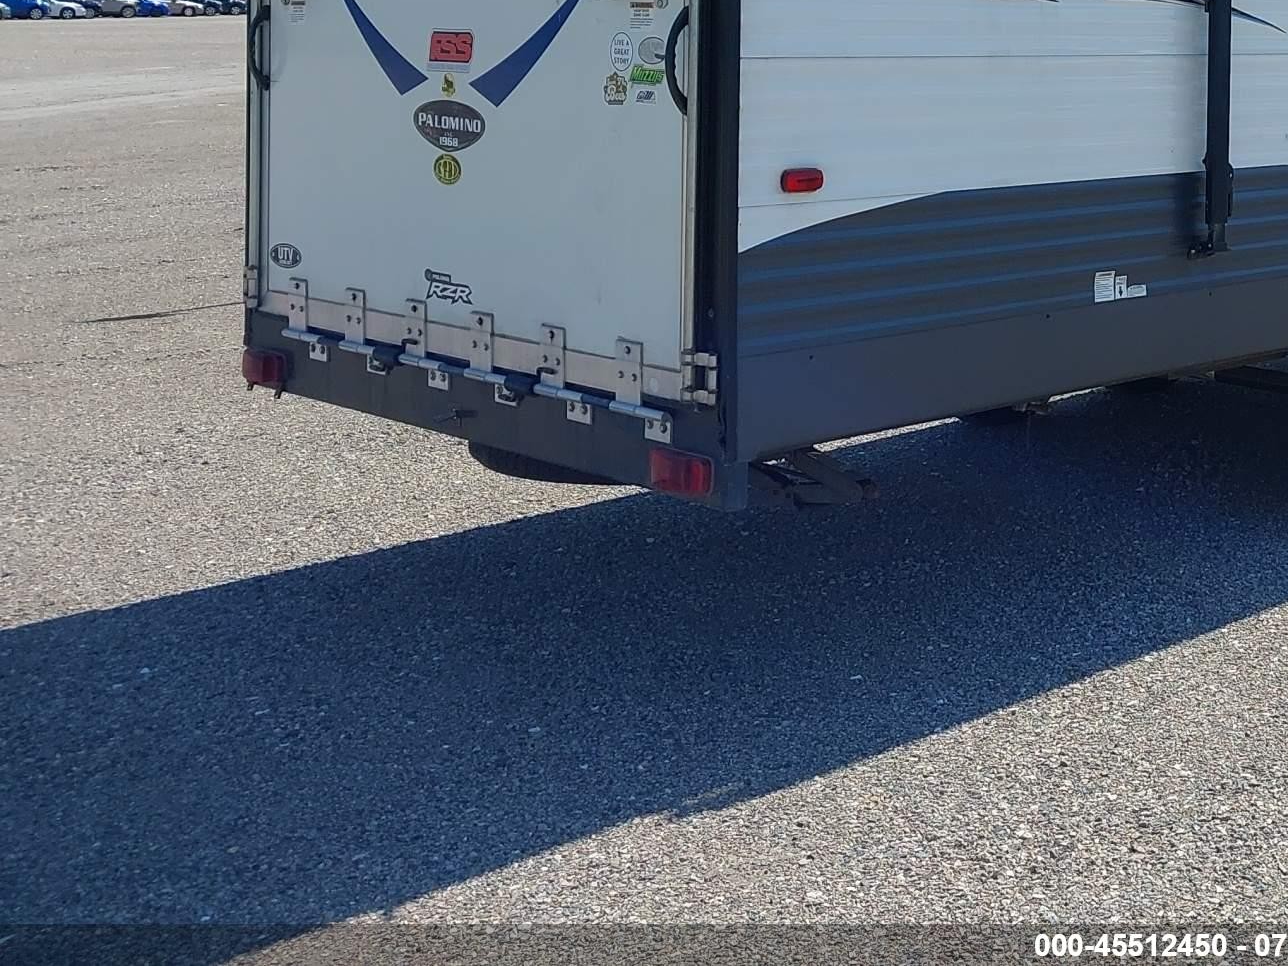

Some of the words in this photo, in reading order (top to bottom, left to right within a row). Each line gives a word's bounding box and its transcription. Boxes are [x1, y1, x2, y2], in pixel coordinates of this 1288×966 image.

[418, 112, 481, 133] PALOMINO
[440, 136, 459, 147] 1968
[428, 282, 472, 304] RZR
